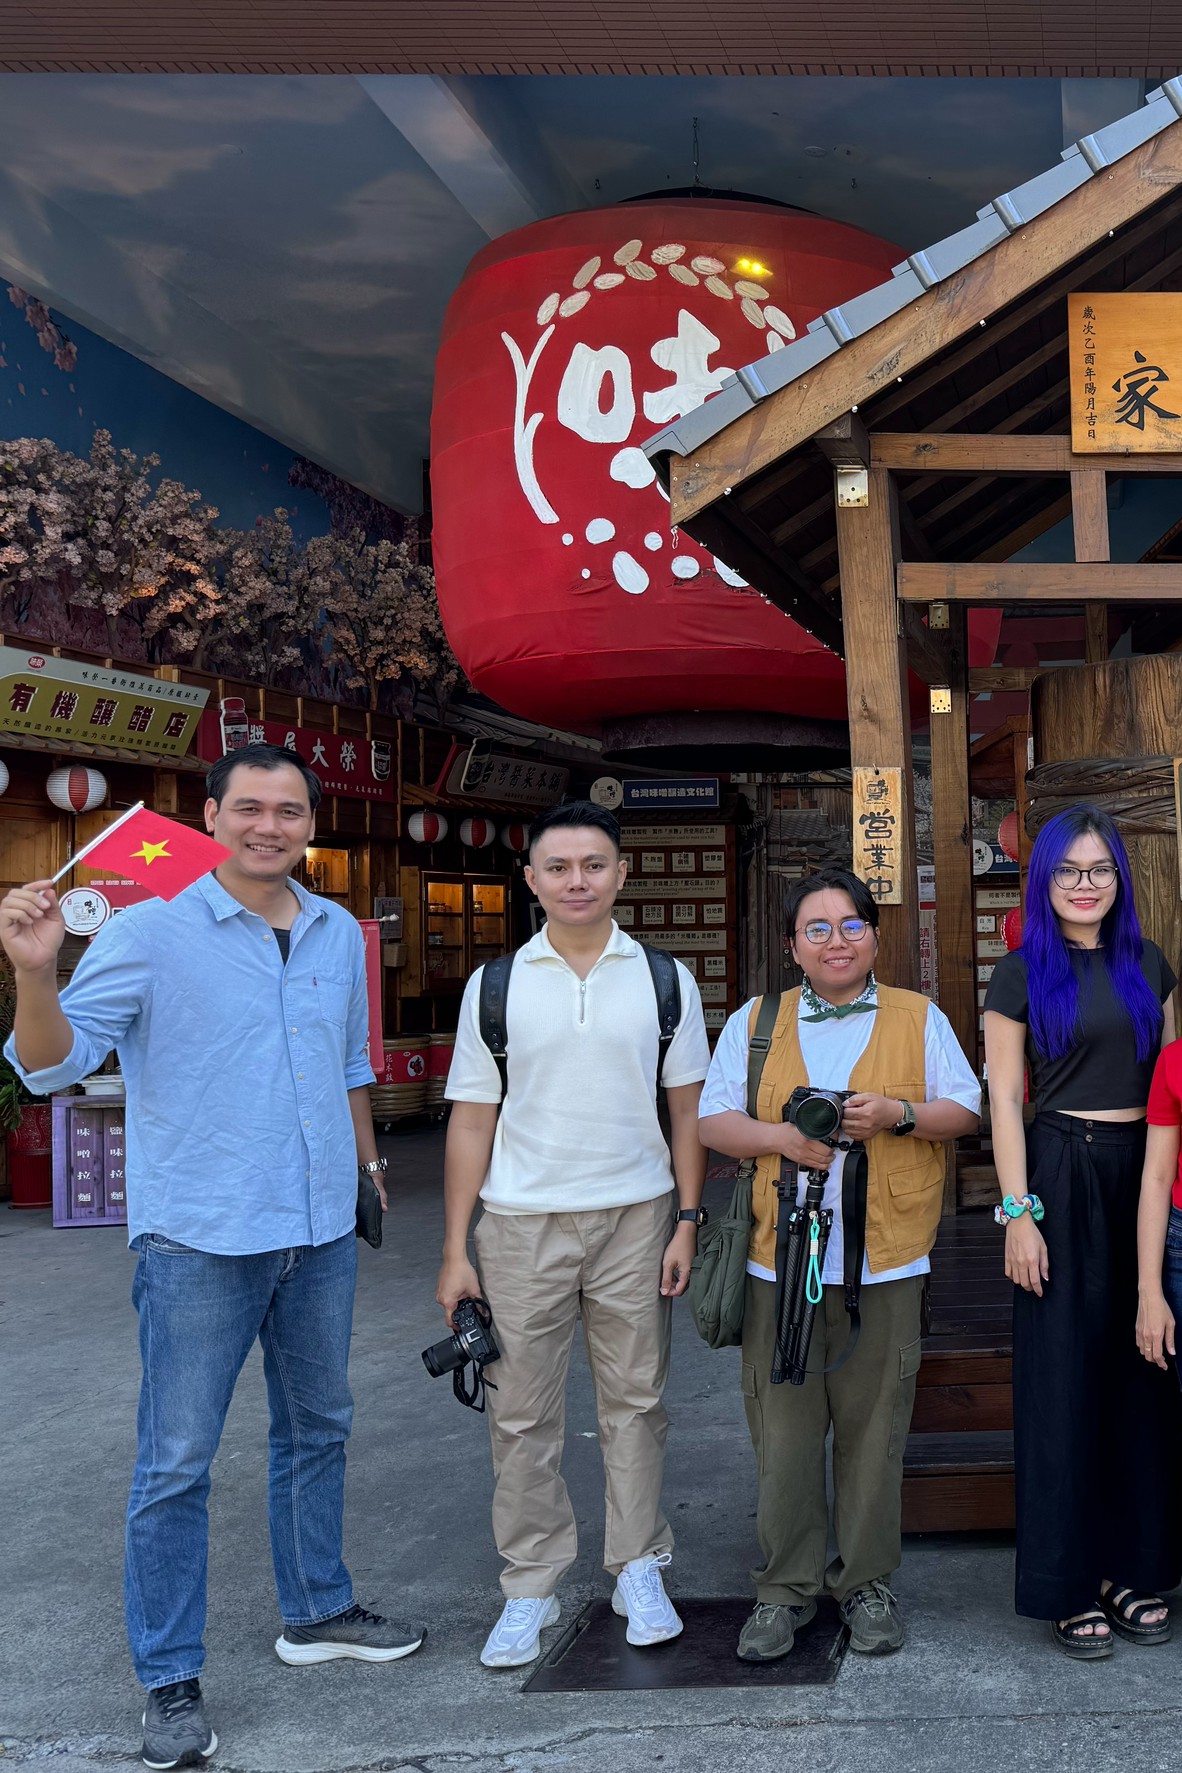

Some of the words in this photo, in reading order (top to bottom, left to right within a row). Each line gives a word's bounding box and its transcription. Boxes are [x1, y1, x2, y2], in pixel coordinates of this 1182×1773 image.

[8, 682, 190, 738] 有機釀醋店
